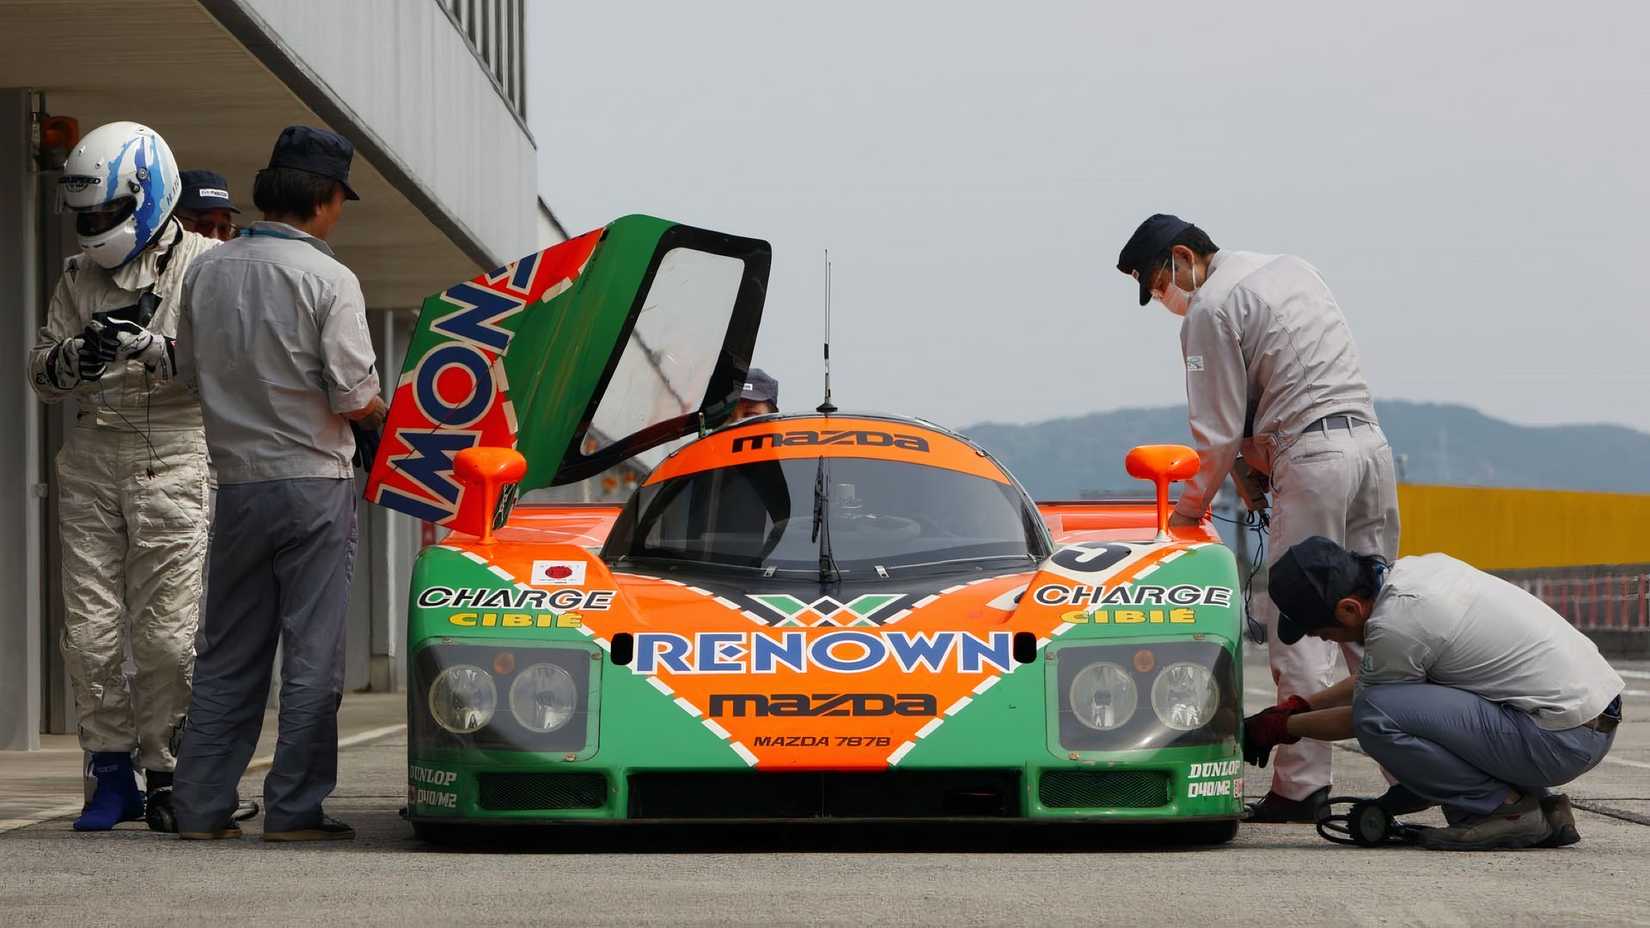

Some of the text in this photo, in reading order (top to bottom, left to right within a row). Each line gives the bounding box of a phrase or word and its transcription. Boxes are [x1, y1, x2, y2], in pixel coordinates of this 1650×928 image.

[418, 586, 616, 610] CHARGE
[1034, 585, 1232, 607] CHARGE
[633, 631, 1014, 674] RENOWN
[754, 736, 891, 747] MAZDA 787B
[410, 765, 457, 786] DUNLOP
[1188, 760, 1240, 778] DUNLOP
